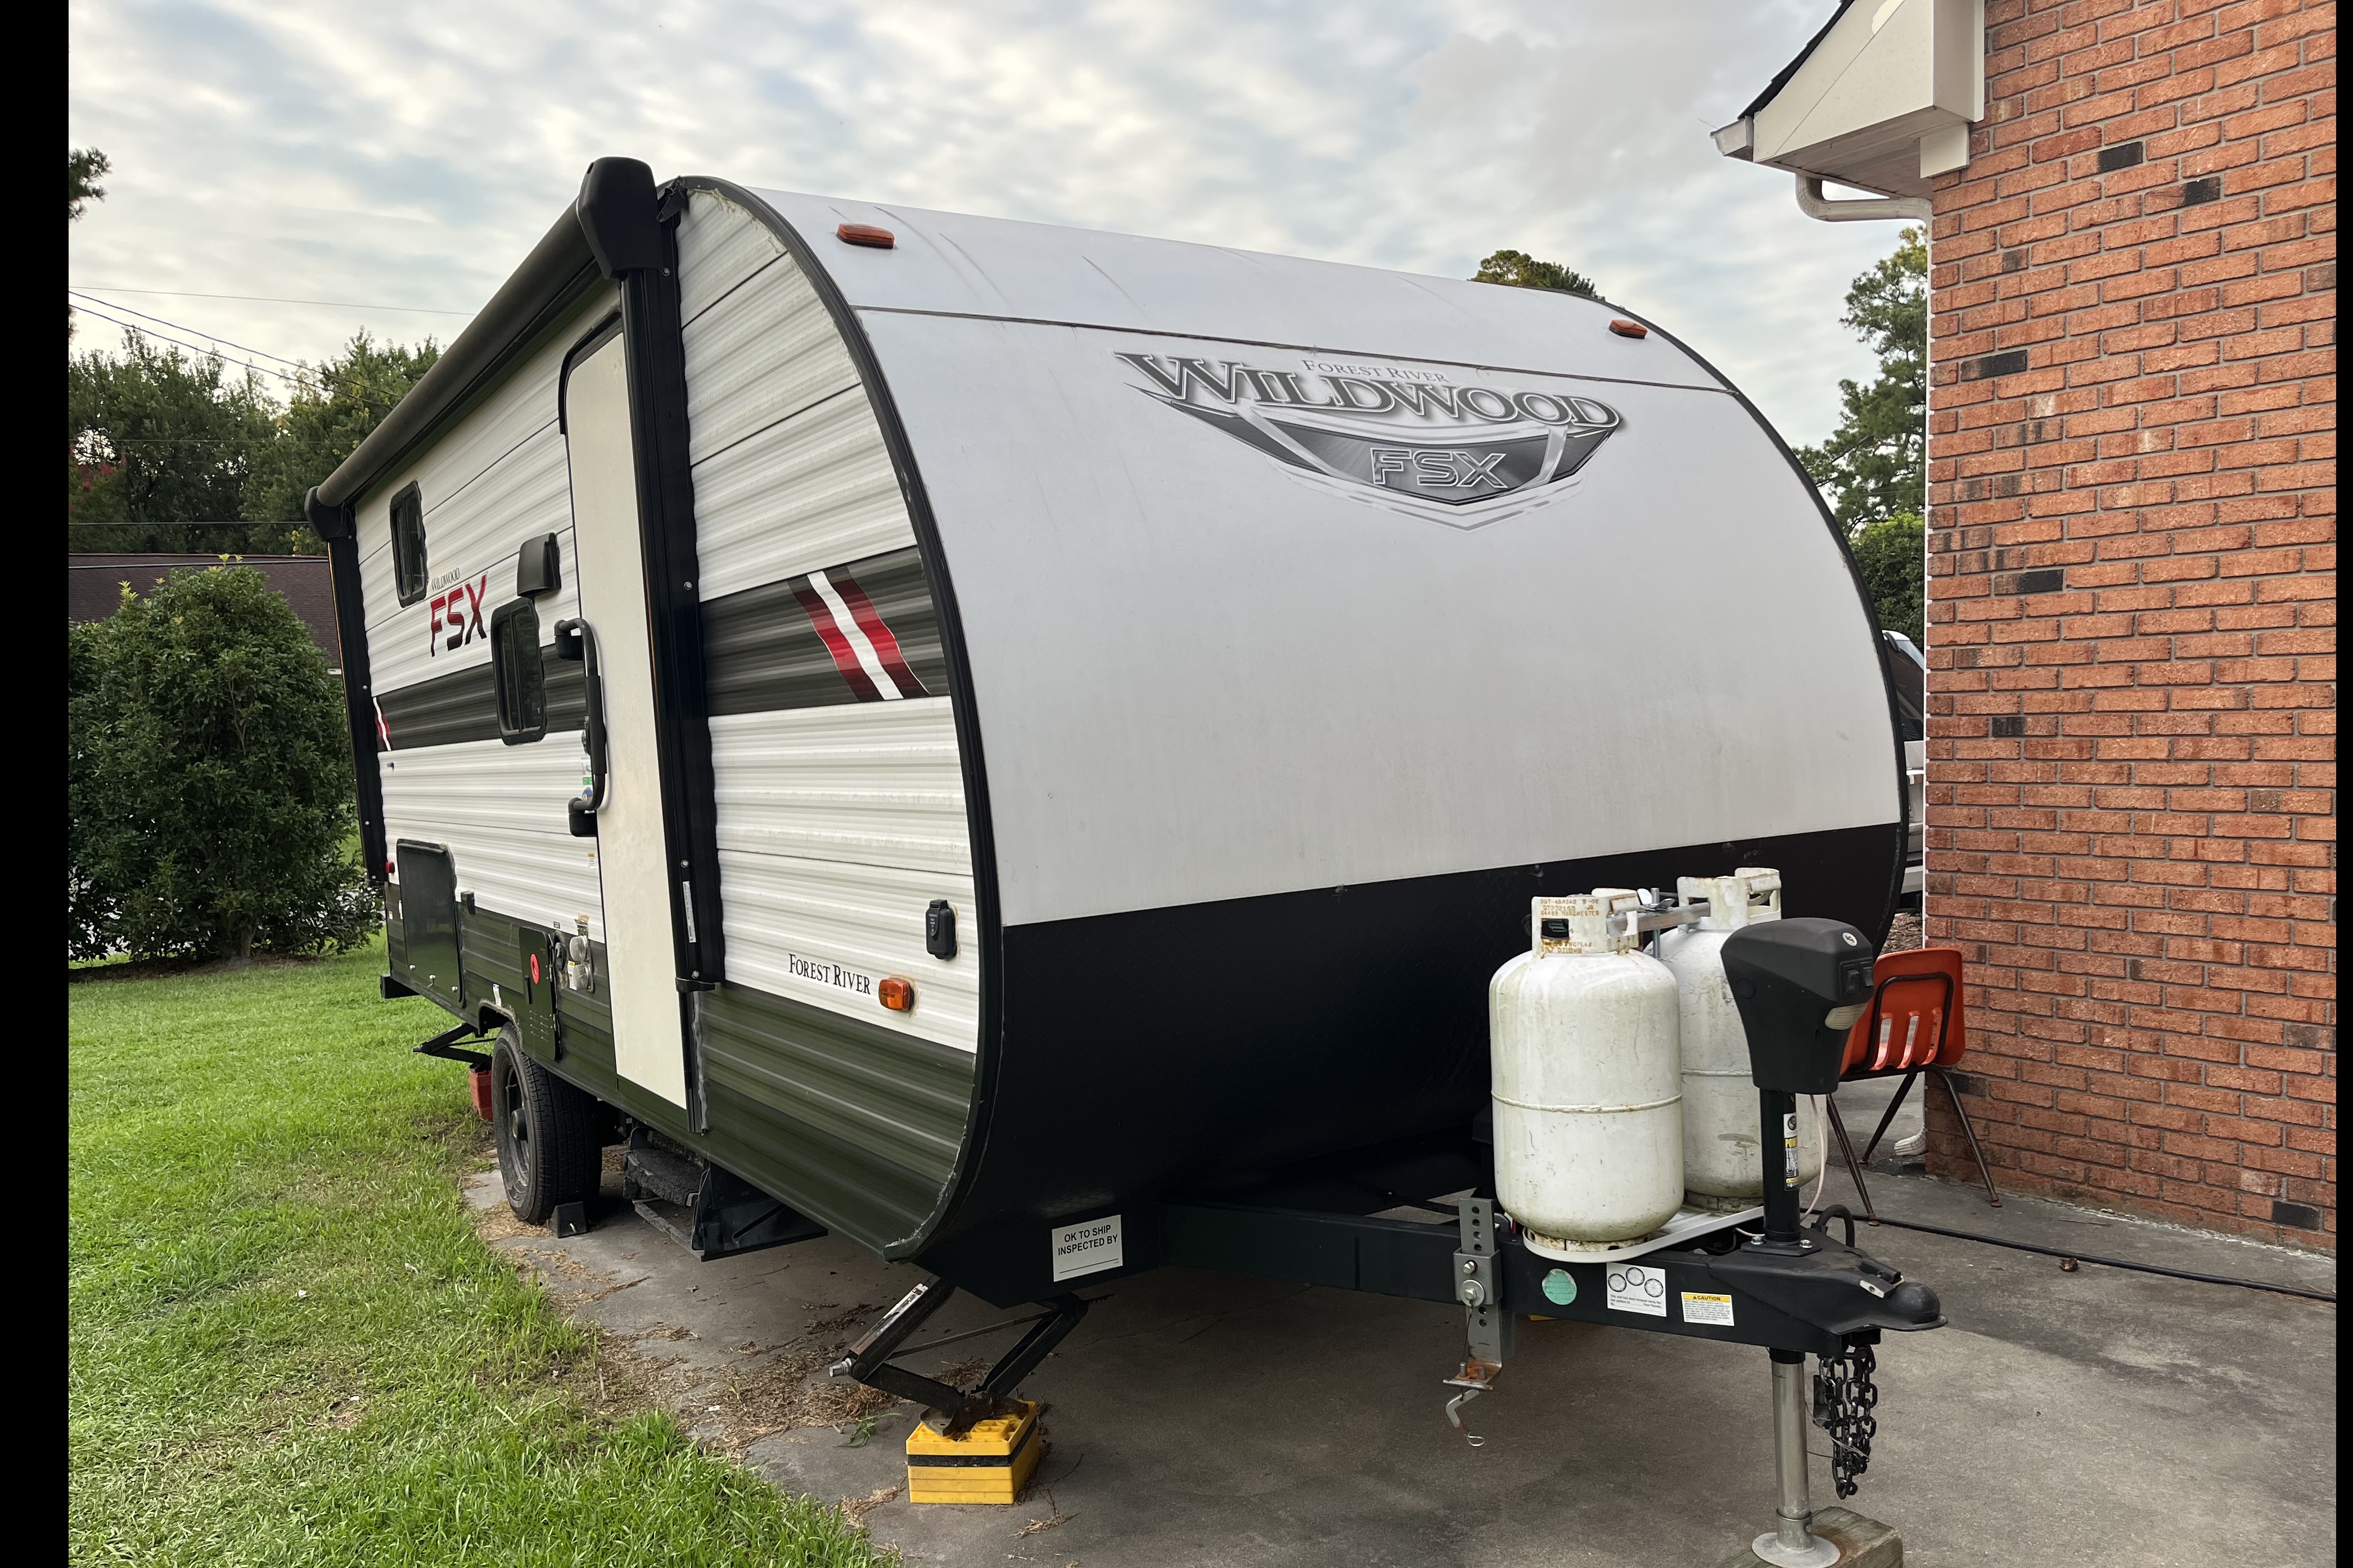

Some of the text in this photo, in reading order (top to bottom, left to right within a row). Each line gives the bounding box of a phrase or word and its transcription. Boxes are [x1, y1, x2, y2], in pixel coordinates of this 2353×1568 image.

[1112, 350, 1620, 427] WILDWOOD
[1300, 359, 1450, 383] FOREST RIVER
[1370, 447, 1508, 489] FSX
[430, 571, 488, 657] FSX
[788, 953, 871, 995] FOREST RIVER
[1058, 1233, 1118, 1256] INSPECTED BY
[1064, 1224, 1111, 1242] OK TO SHIP
